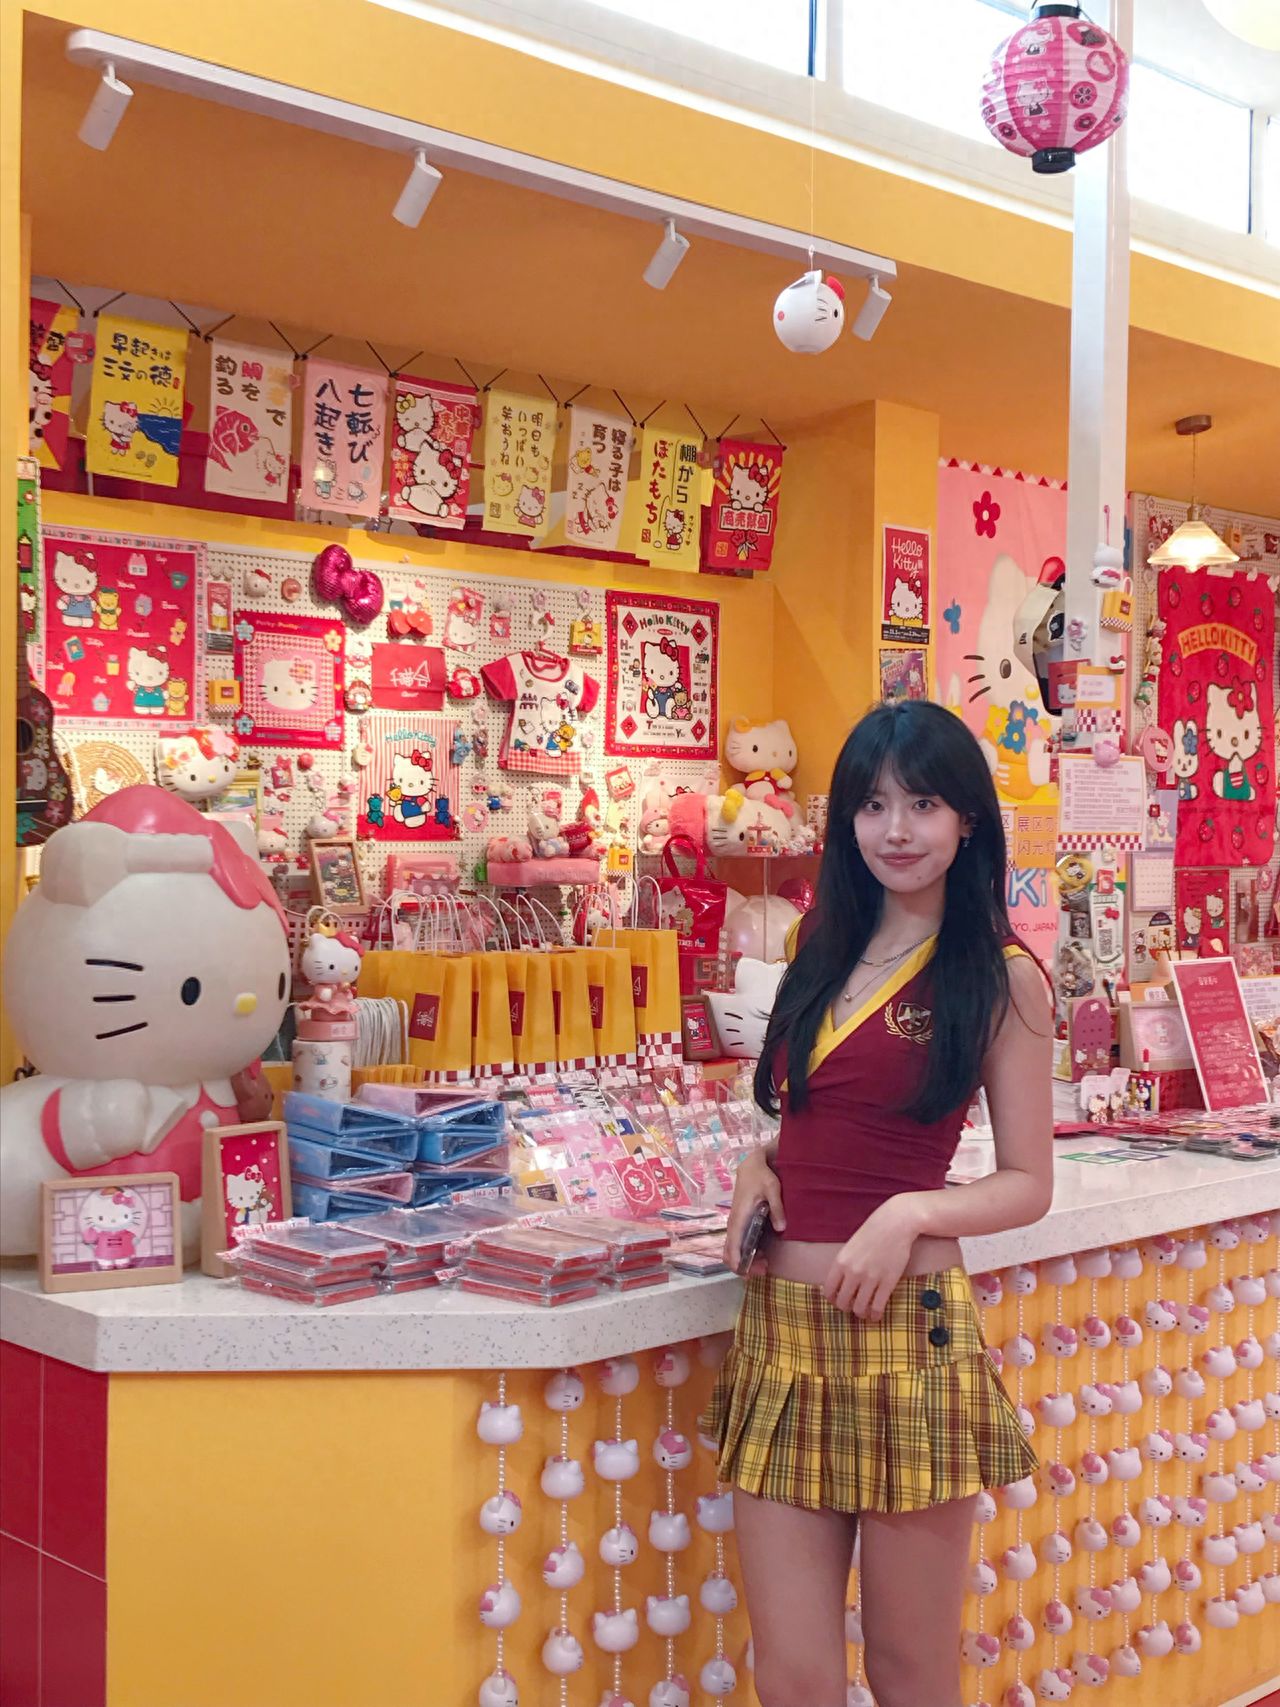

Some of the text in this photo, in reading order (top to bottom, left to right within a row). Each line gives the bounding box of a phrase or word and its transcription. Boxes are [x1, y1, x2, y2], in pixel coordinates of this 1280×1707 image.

[111, 332, 172, 360] 早起きは
[103, 356, 172, 387] 三文の徳
[215, 354, 238, 396] 釣る
[314, 378, 342, 456] 八起き
[345, 383, 375, 464] 七転び
[500, 406, 512, 466] 笑おうね
[531, 412, 544, 458] 明日も
[592, 423, 608, 454] 育つ
[607, 427, 627, 492] 寝る子は
[645, 439, 673, 525] ぼたもち
[676, 444, 697, 504] 棚から
[891, 537, 923, 579] Hello Kitty
[640, 614, 690, 635] Hello Kitty
[1181, 626, 1255, 663] HELLO KITTY
[385, 728, 413, 742] Hello
[1033, 922, 1057, 932] JAPAN
